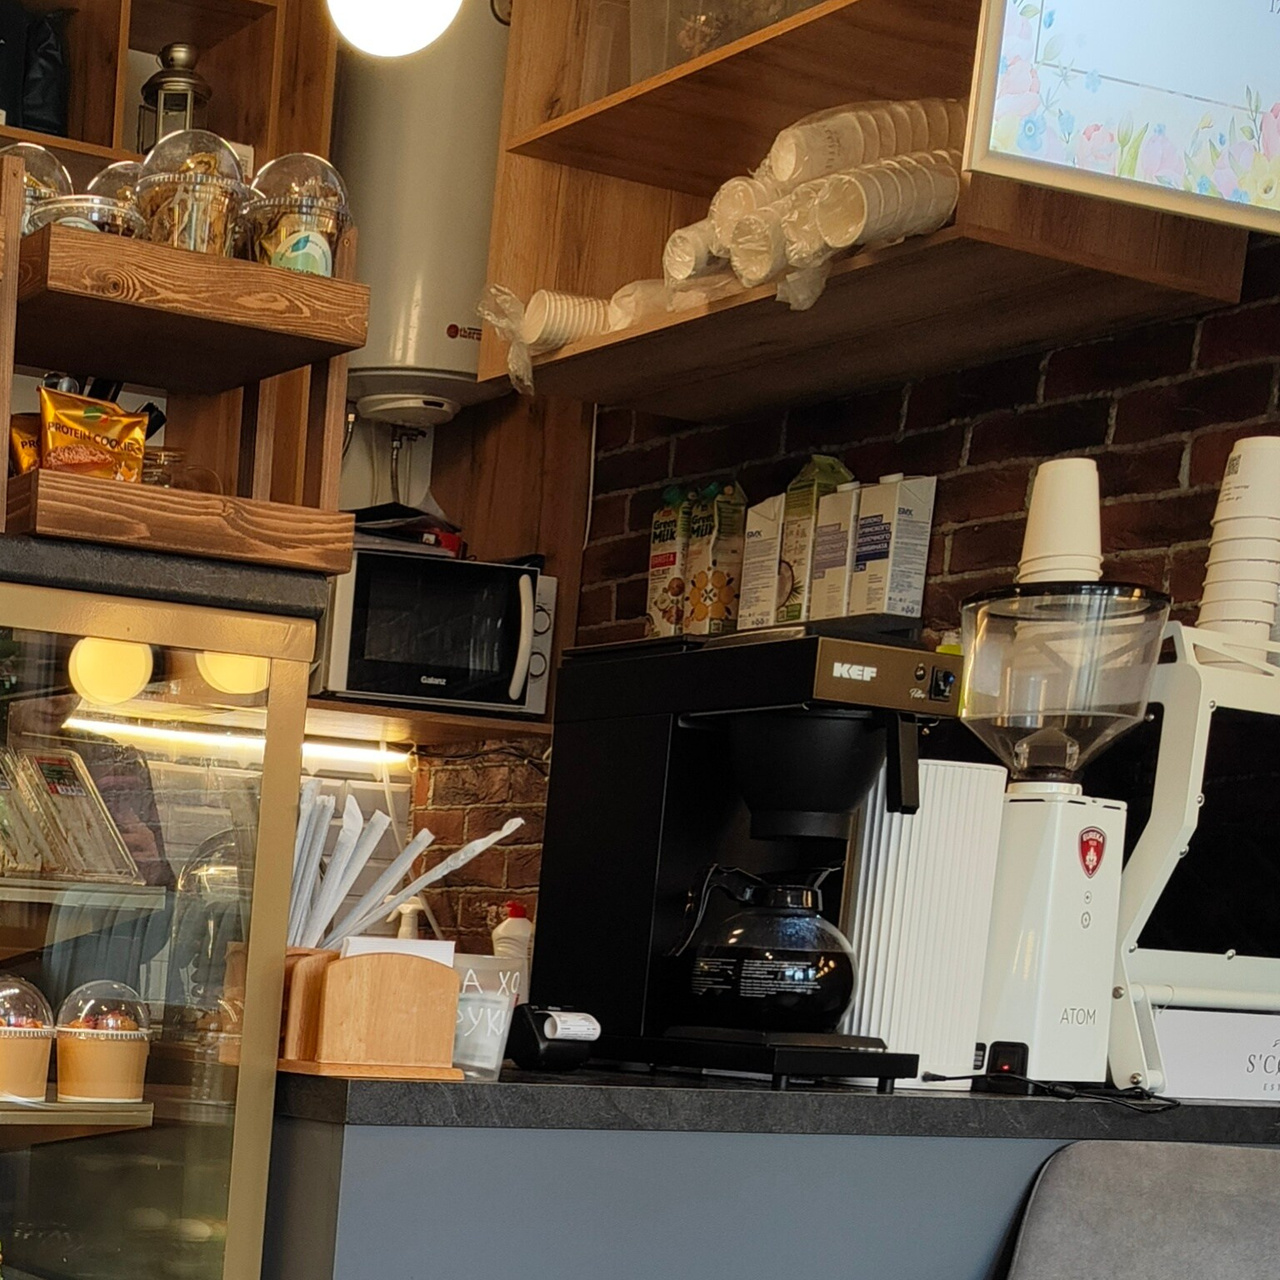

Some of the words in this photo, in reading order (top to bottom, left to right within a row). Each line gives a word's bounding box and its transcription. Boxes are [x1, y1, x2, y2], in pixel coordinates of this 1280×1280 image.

[48, 421, 91, 441] PROTEIN
[652, 530, 677, 544] Milk
[832, 662, 877, 681] KEF
[420, 675, 447, 686] Galanz
[1083, 831, 1104, 844] EUREKA
[1060, 1008, 1097, 1025] ATOM
[1246, 1053, 1280, 1076] S'C
